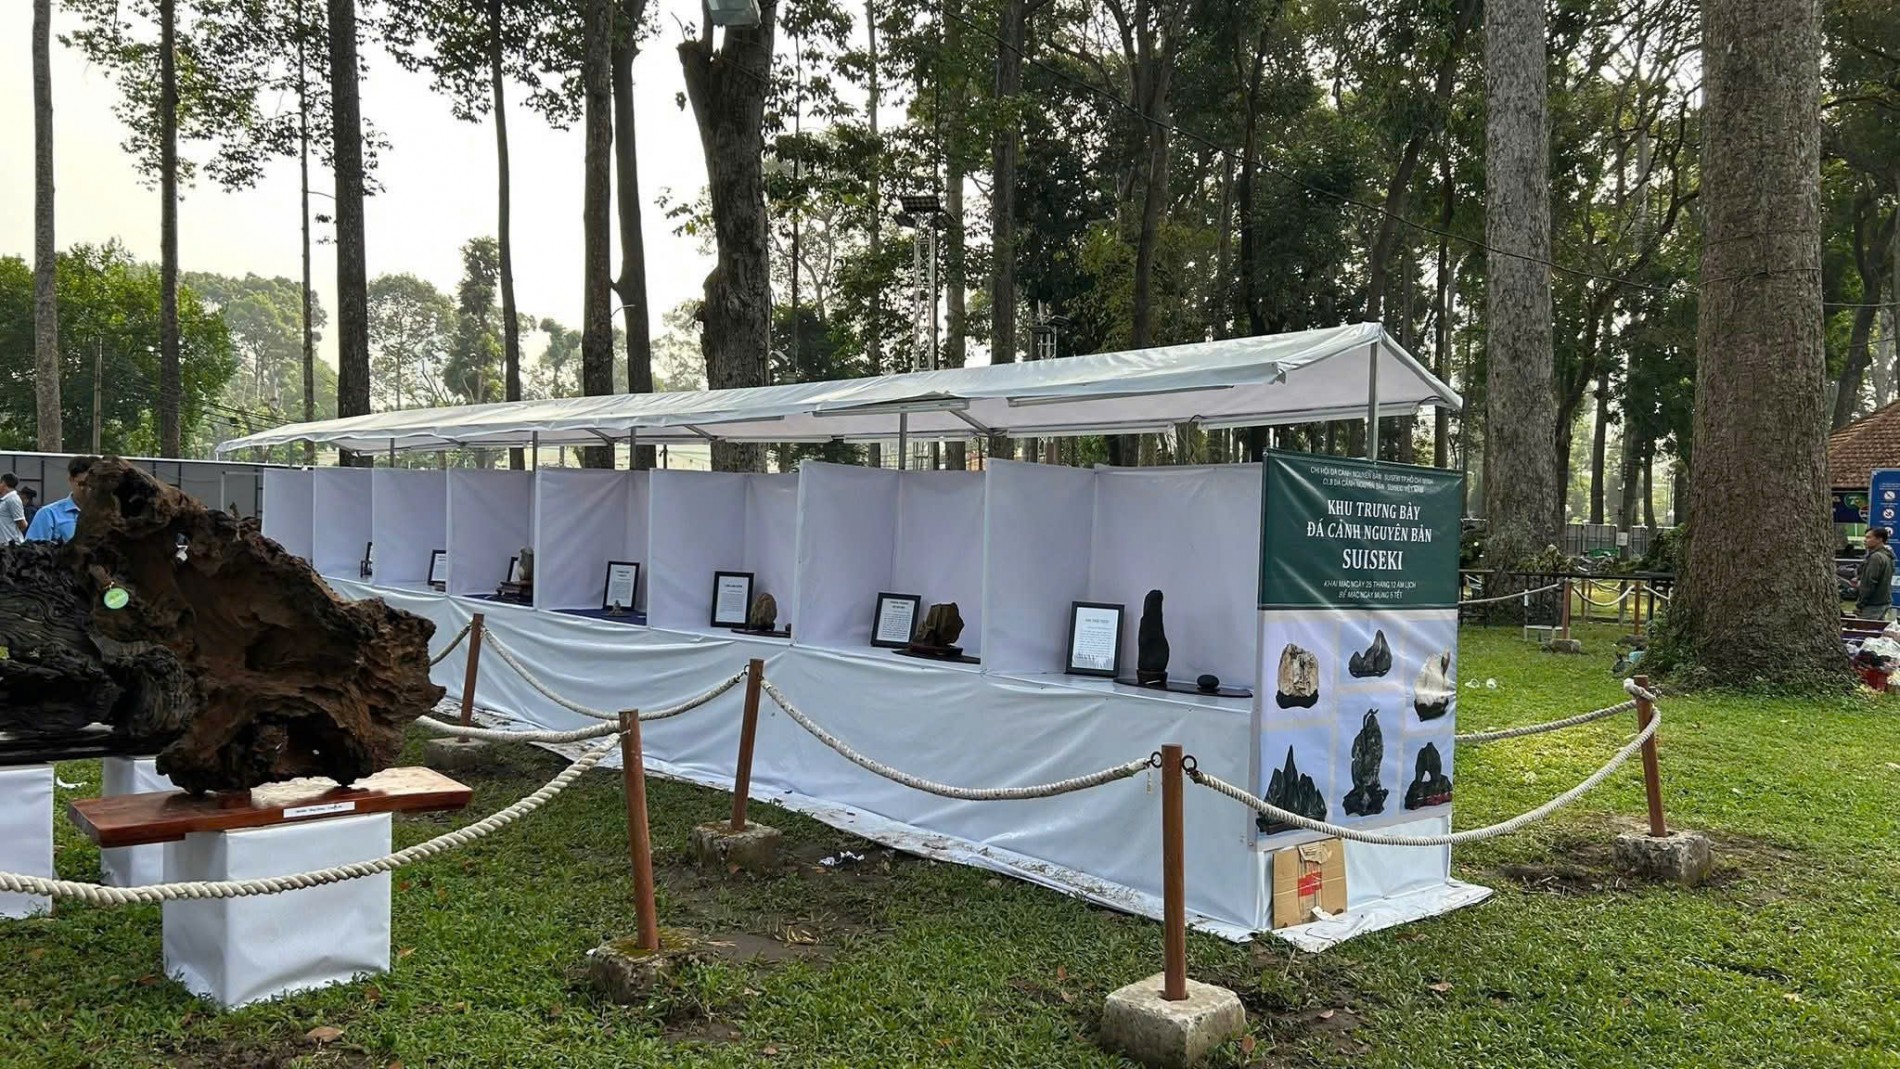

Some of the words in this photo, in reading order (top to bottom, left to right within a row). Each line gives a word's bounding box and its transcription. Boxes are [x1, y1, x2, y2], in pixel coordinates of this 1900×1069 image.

[1328, 500, 1352, 516] KHU
[1356, 502, 1396, 518] TRƯNG
[1400, 502, 1420, 520] BÀY
[1307, 518, 1324, 537] ĐÁ
[1328, 518, 1360, 539] CẢNH
[1364, 523, 1408, 542] NGUYÊN
[1411, 524, 1432, 542] BẢN
[1342, 549, 1403, 570] SUISEKI
